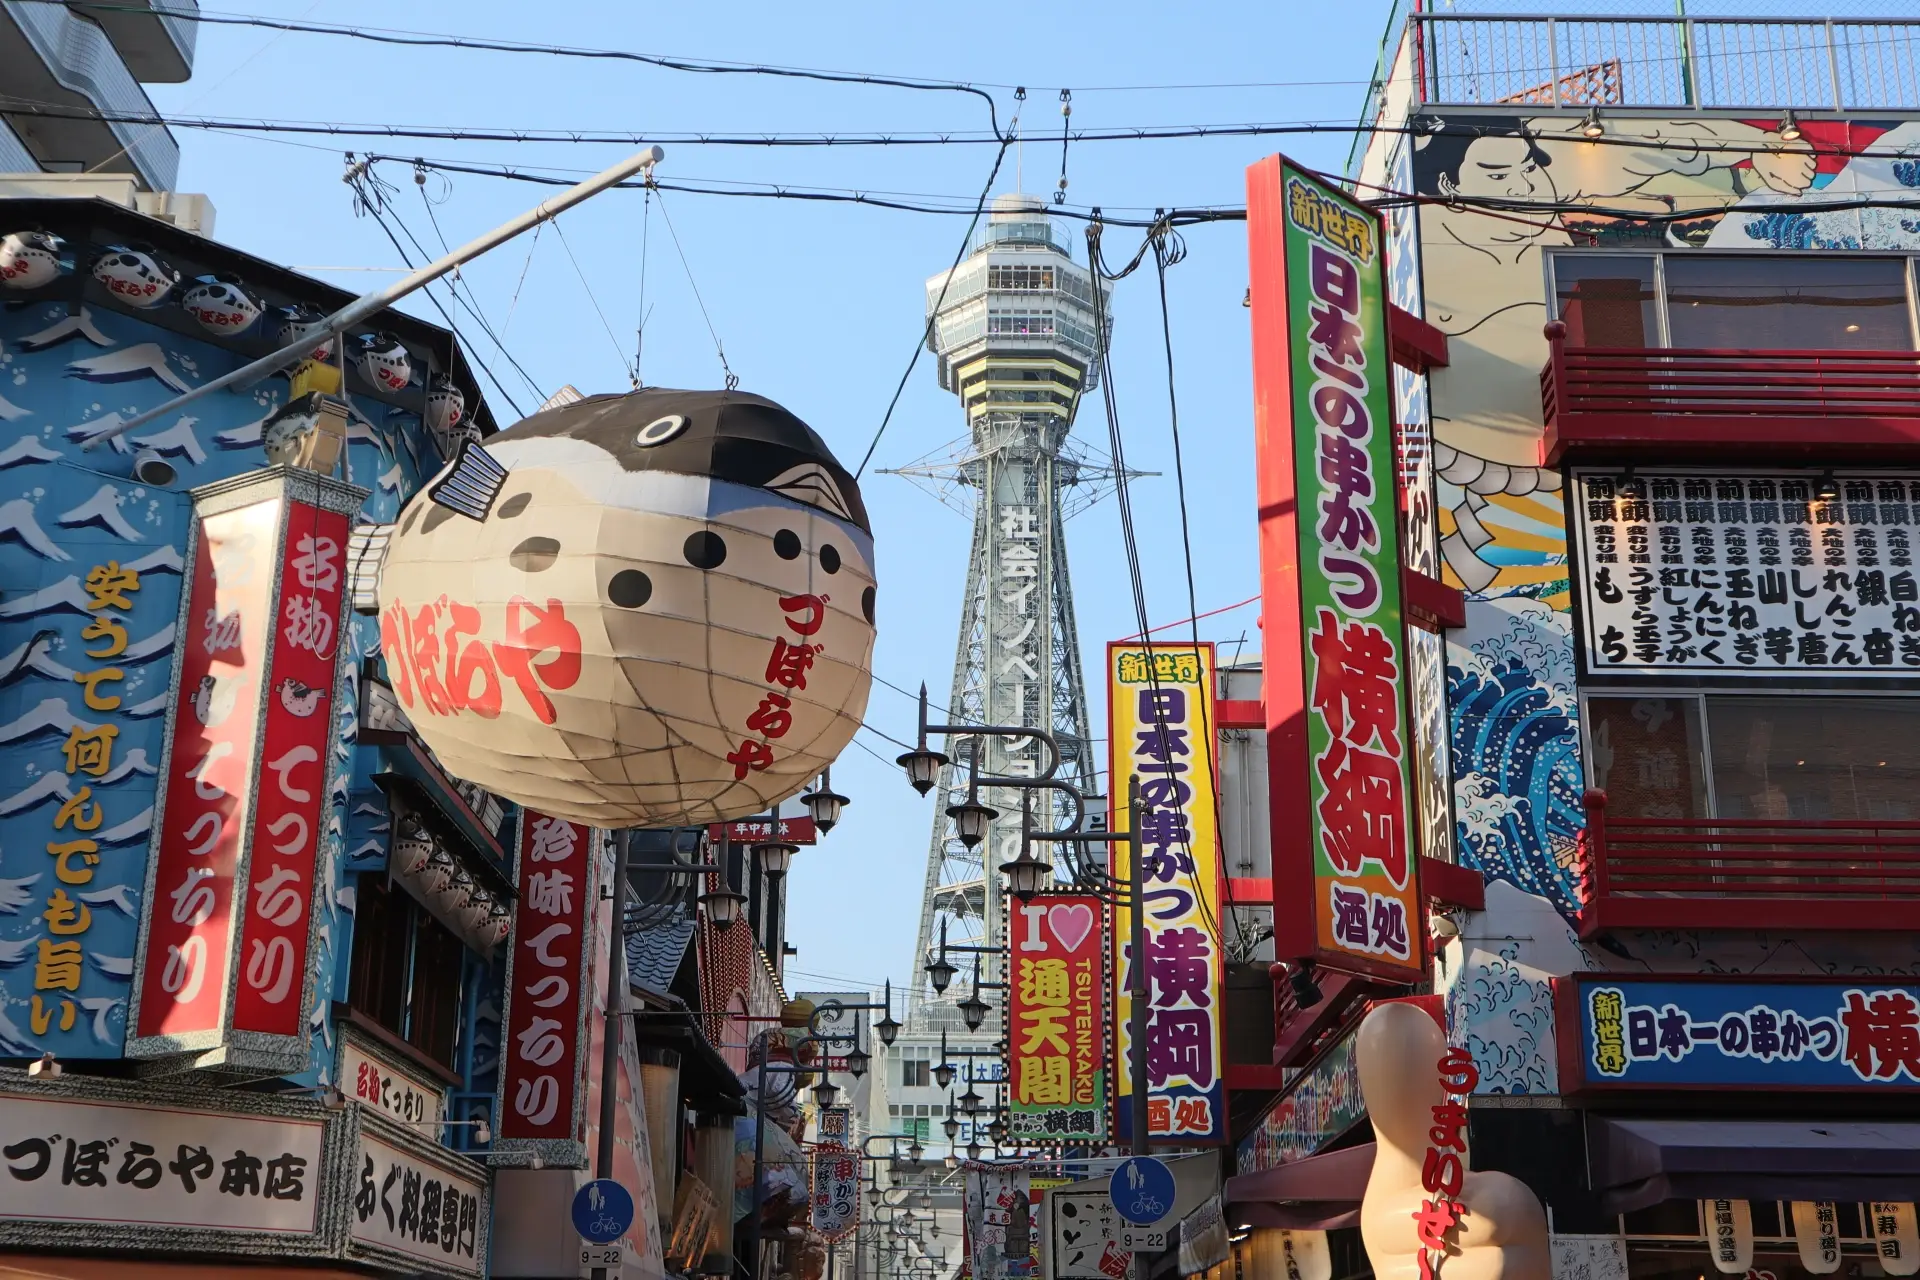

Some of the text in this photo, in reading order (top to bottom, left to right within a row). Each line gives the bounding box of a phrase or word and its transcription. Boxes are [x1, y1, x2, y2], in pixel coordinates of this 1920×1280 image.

[1289, 179, 1374, 264] 新世界
[1310, 244, 1378, 610] 日本一の串かつ
[381, 593, 582, 725] づぼらや
[1594, 566, 1628, 664] もち
[1627, 566, 1664, 664] うずら玉子
[1658, 567, 1698, 664] 紅しょうが
[1690, 569, 1727, 665] にんにく
[1724, 568, 1762, 665] 玉ねぎ
[1757, 568, 1795, 666] 山芋
[1791, 569, 1829, 666] しし唐
[1823, 569, 1862, 666] れんこん
[1853, 570, 1895, 666] 銀杏
[727, 593, 831, 780] づぼらや
[1119, 652, 1202, 683] 新世界
[246, 532, 339, 1004] 名物 てっちり
[1312, 610, 1407, 886] 横綱
[29, 560, 140, 1036] 安うて何んでも旨い
[1135, 688, 1195, 920] 日本一の串かつ
[161, 741, 234, 1005] てっちり
[1334, 886, 1407, 955] 酒処
[514, 817, 578, 1127] 珍味てっちり
[1020, 905, 1048, 952] I
[1018, 958, 1071, 1105] 通天閣
[1075, 957, 1094, 1104] TSUTENKAKU
[1123, 928, 1211, 1089] 横綱
[1592, 992, 1627, 1074] 新世界
[1628, 1007, 1838, 1058] 日本一の串かつ
[4, 1134, 307, 1202] づぼらや本店
[1043, 1110, 1095, 1135] 横綱
[355, 1152, 477, 1259] ふぐ料理専門
[832, 1156, 856, 1218] 串かつ
